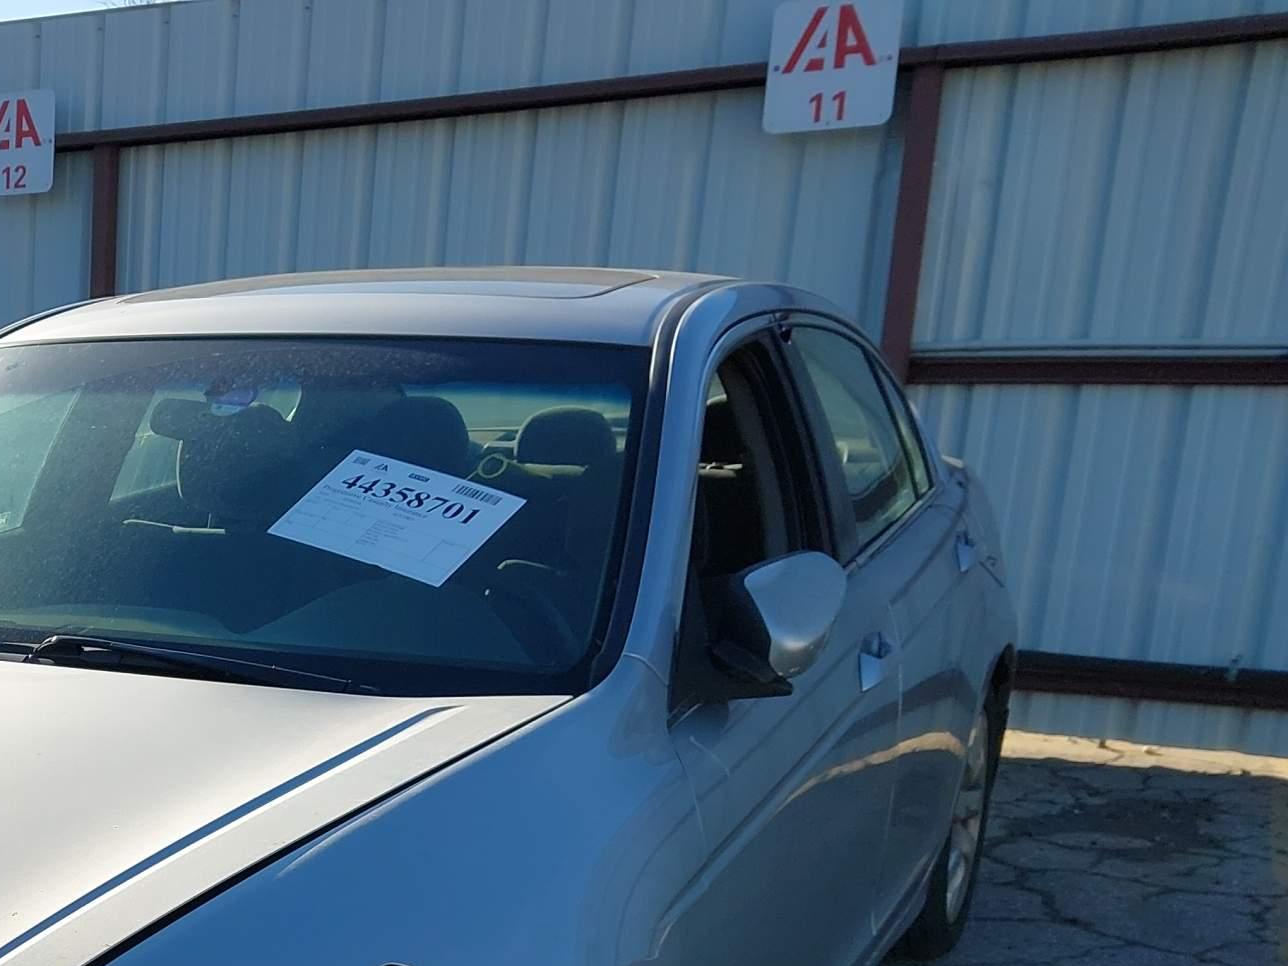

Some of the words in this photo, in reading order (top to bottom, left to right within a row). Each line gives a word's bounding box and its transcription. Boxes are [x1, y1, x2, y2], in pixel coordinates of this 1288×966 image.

[809, 90, 847, 123] 11
[1, 164, 27, 190] 12
[341, 474, 481, 525] 44358701
